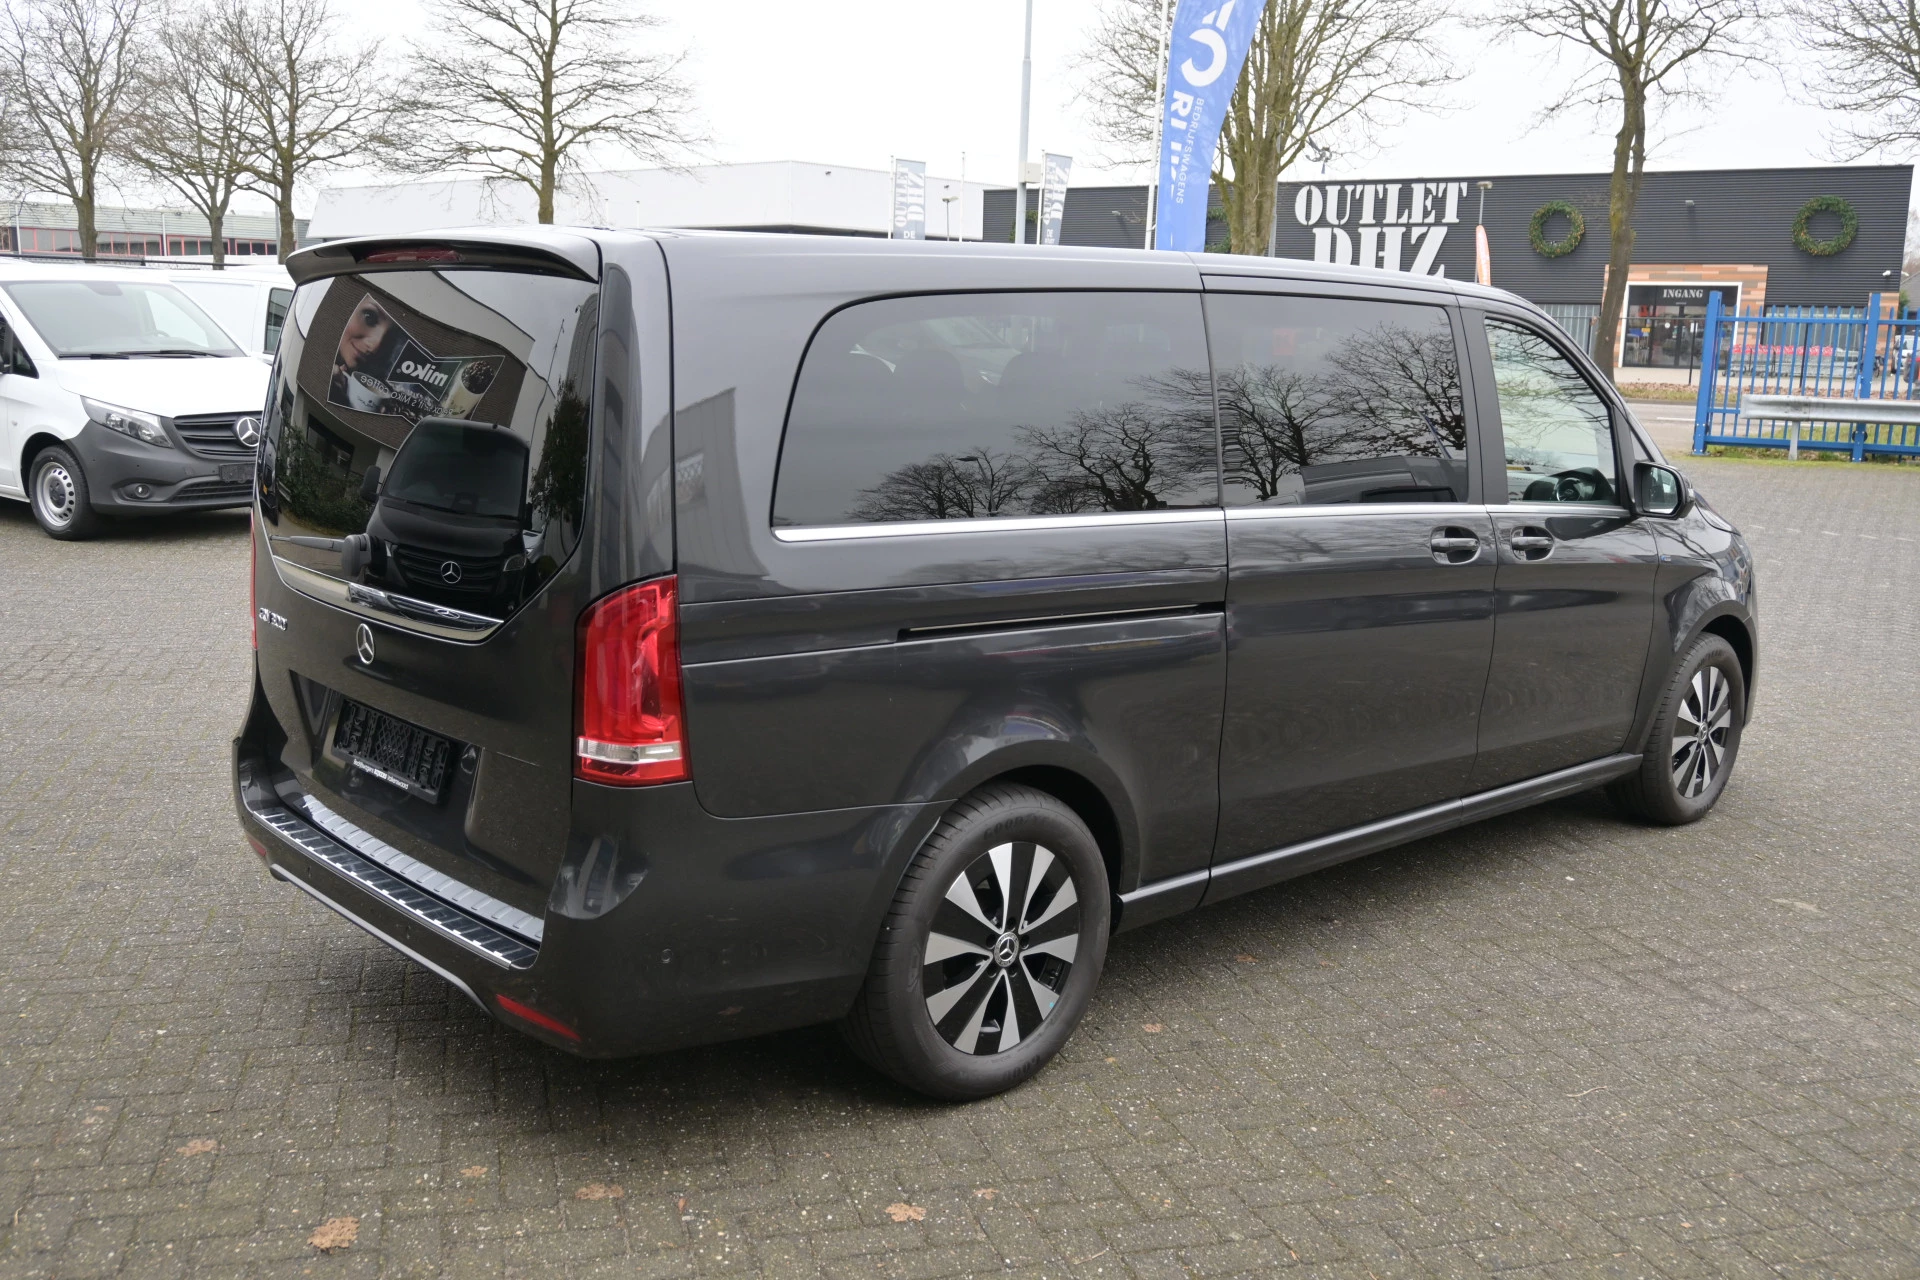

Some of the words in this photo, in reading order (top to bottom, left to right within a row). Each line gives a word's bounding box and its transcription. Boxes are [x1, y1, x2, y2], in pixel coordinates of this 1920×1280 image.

[1175, 98, 1205, 205] BEDRIJFSWAGENS
[907, 171, 924, 222] DHZ
[1294, 181, 1468, 226] OUTLET
[903, 230, 916, 239] DE
[1312, 226, 1448, 278] DHZ
[1662, 288, 1704, 299] INGANG
